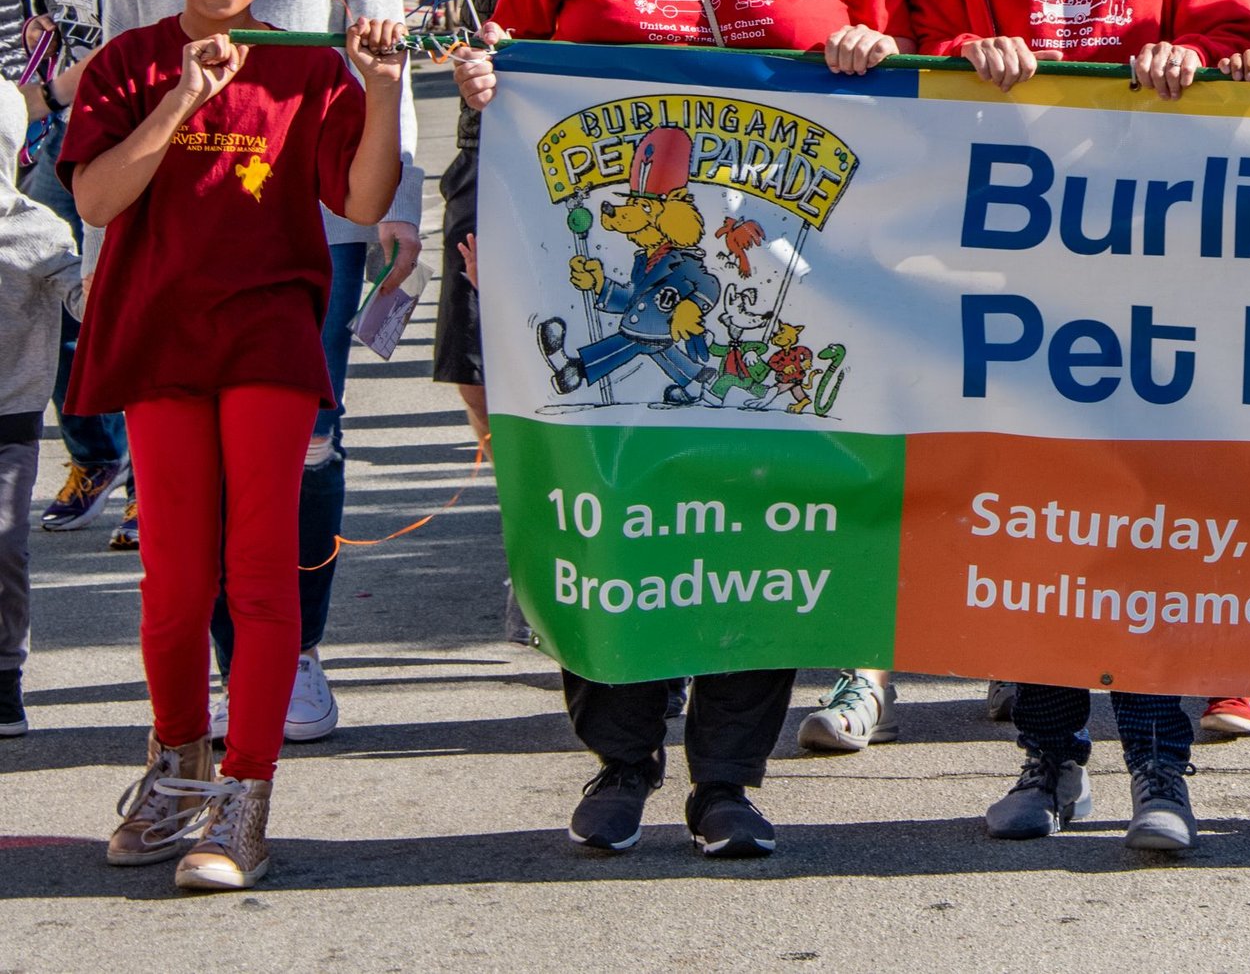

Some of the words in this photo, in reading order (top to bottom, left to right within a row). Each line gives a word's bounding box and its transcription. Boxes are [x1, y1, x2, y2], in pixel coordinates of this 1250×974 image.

[639, 21, 677, 31] United
[680, 23, 733, 33] Methoist
[734, 17, 774, 29] Church
[685, 34, 729, 43] Nursy
[730, 29, 766, 40] School
[1032, 38, 1079, 48] NURSERY
[1081, 36, 1122, 46] SCHOOL
[171, 132, 211, 144] RVEST
[214, 132, 267, 147] FESTIVAL
[204, 145, 236, 153] HAUNTED
[580, 99, 825, 158] BURLINGAME
[689, 131, 841, 218] PARADE
[961, 294, 1196, 405] Pet
[548, 488, 602, 538] 10
[623, 501, 742, 538] a.m.
[765, 502, 837, 532] on
[971, 492, 1247, 563] Saturday,
[555, 558, 831, 613] Broadway
